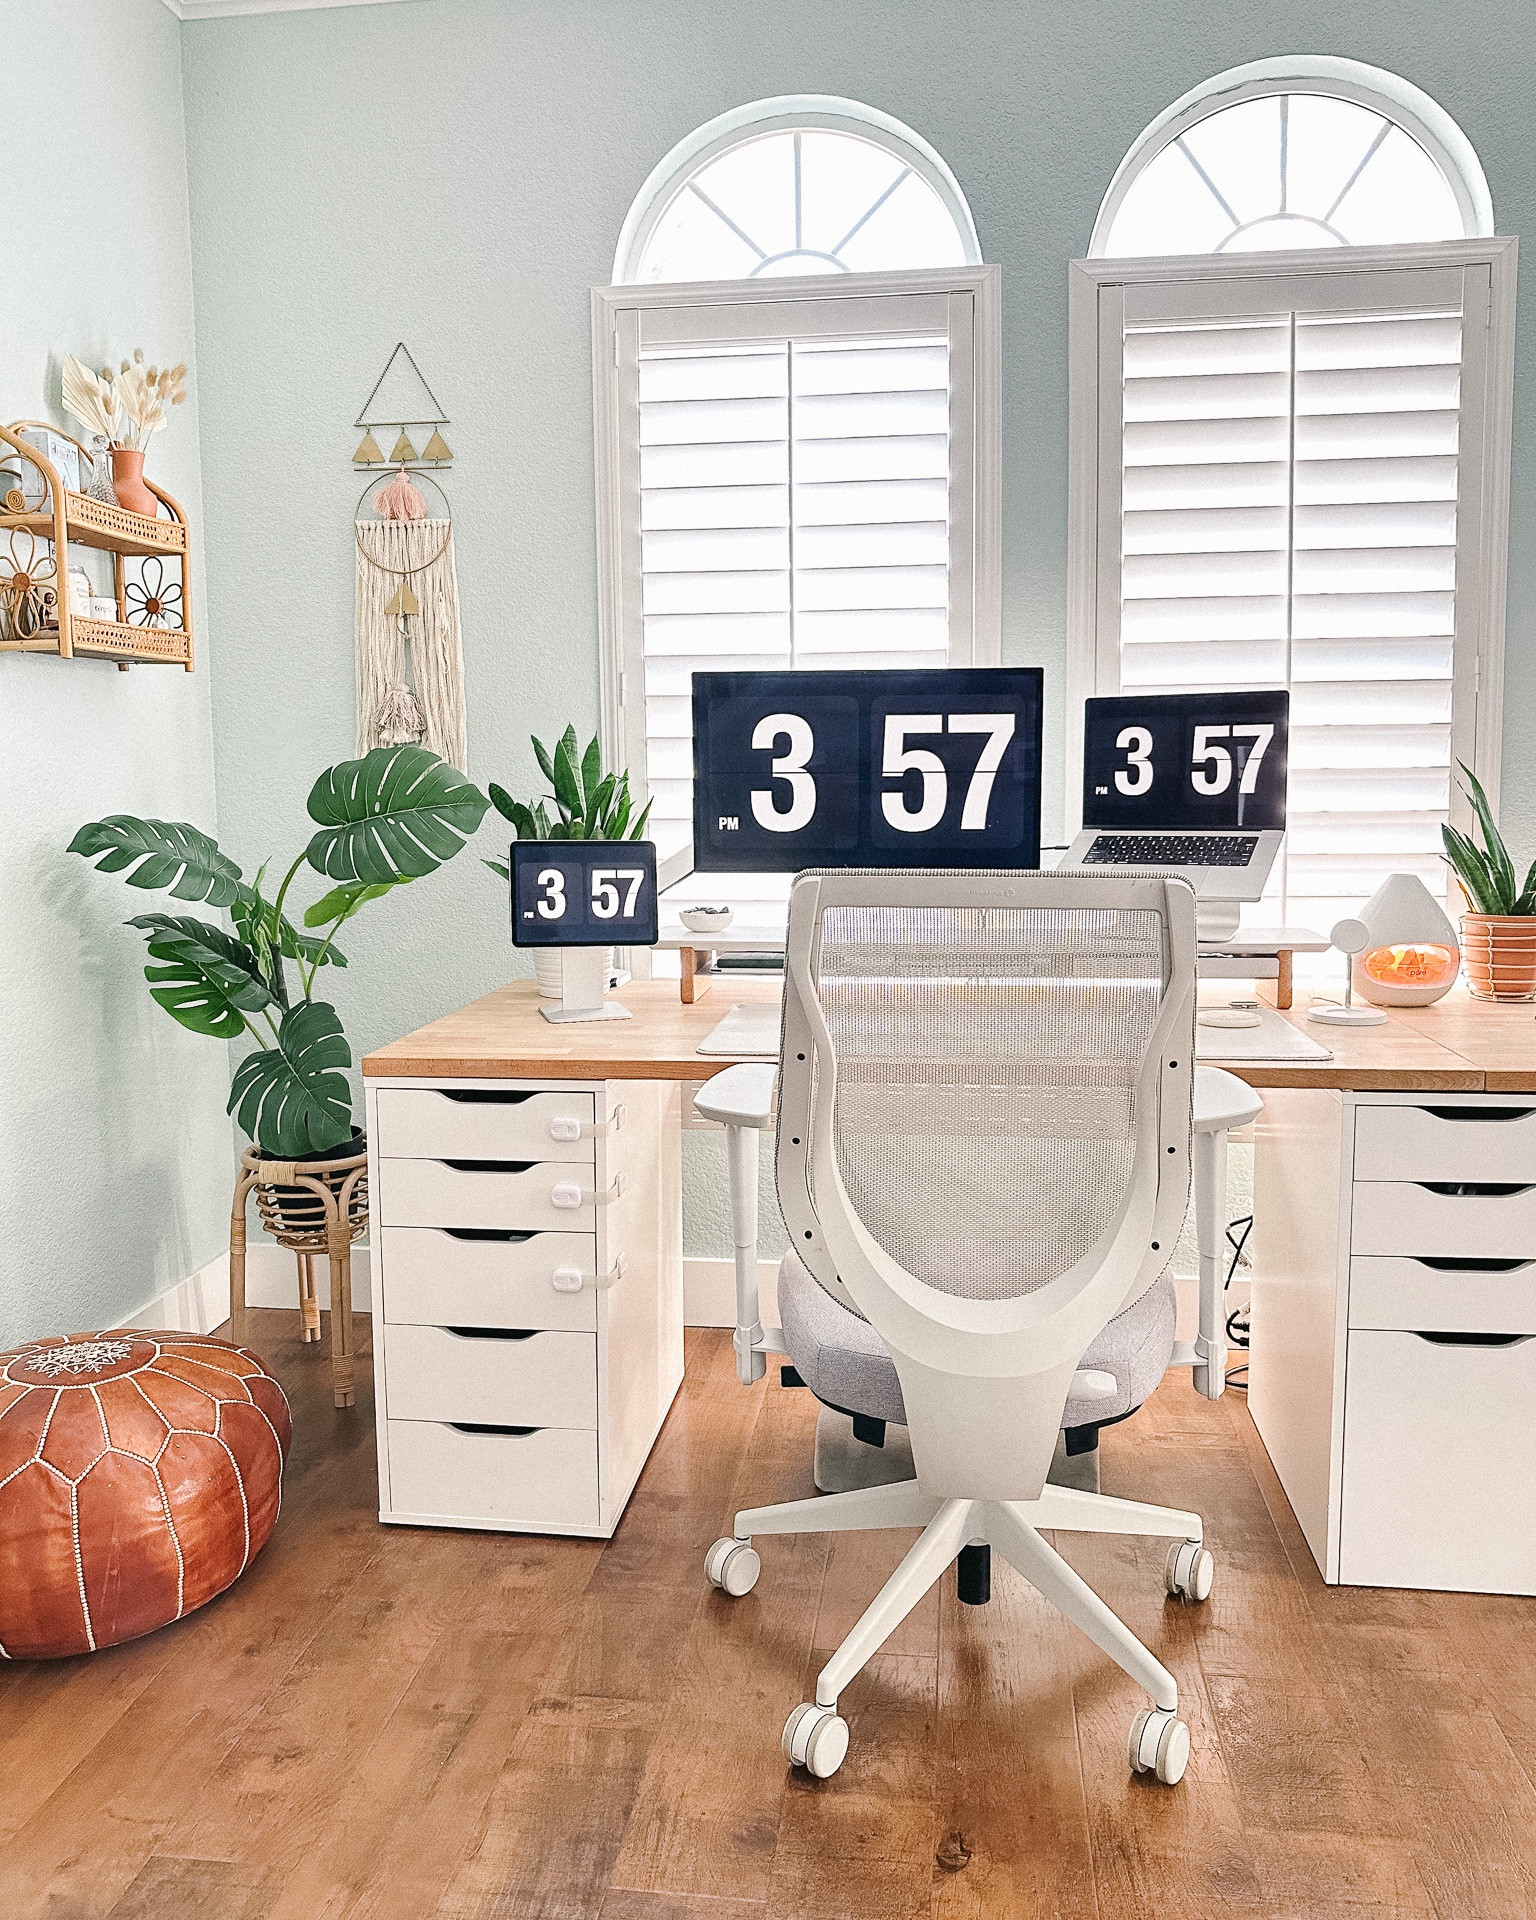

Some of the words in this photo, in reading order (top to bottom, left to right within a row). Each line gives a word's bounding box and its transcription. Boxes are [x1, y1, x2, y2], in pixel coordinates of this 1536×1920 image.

[718, 816, 739, 830] PM
[750, 713, 817, 833] 3
[881, 713, 1016, 833] 57
[1095, 786, 1108, 795] PM
[1114, 726, 1154, 796] 3
[1191, 723, 1275, 796] 57
[537, 868, 567, 920] 3
[591, 869, 645, 919] 57
